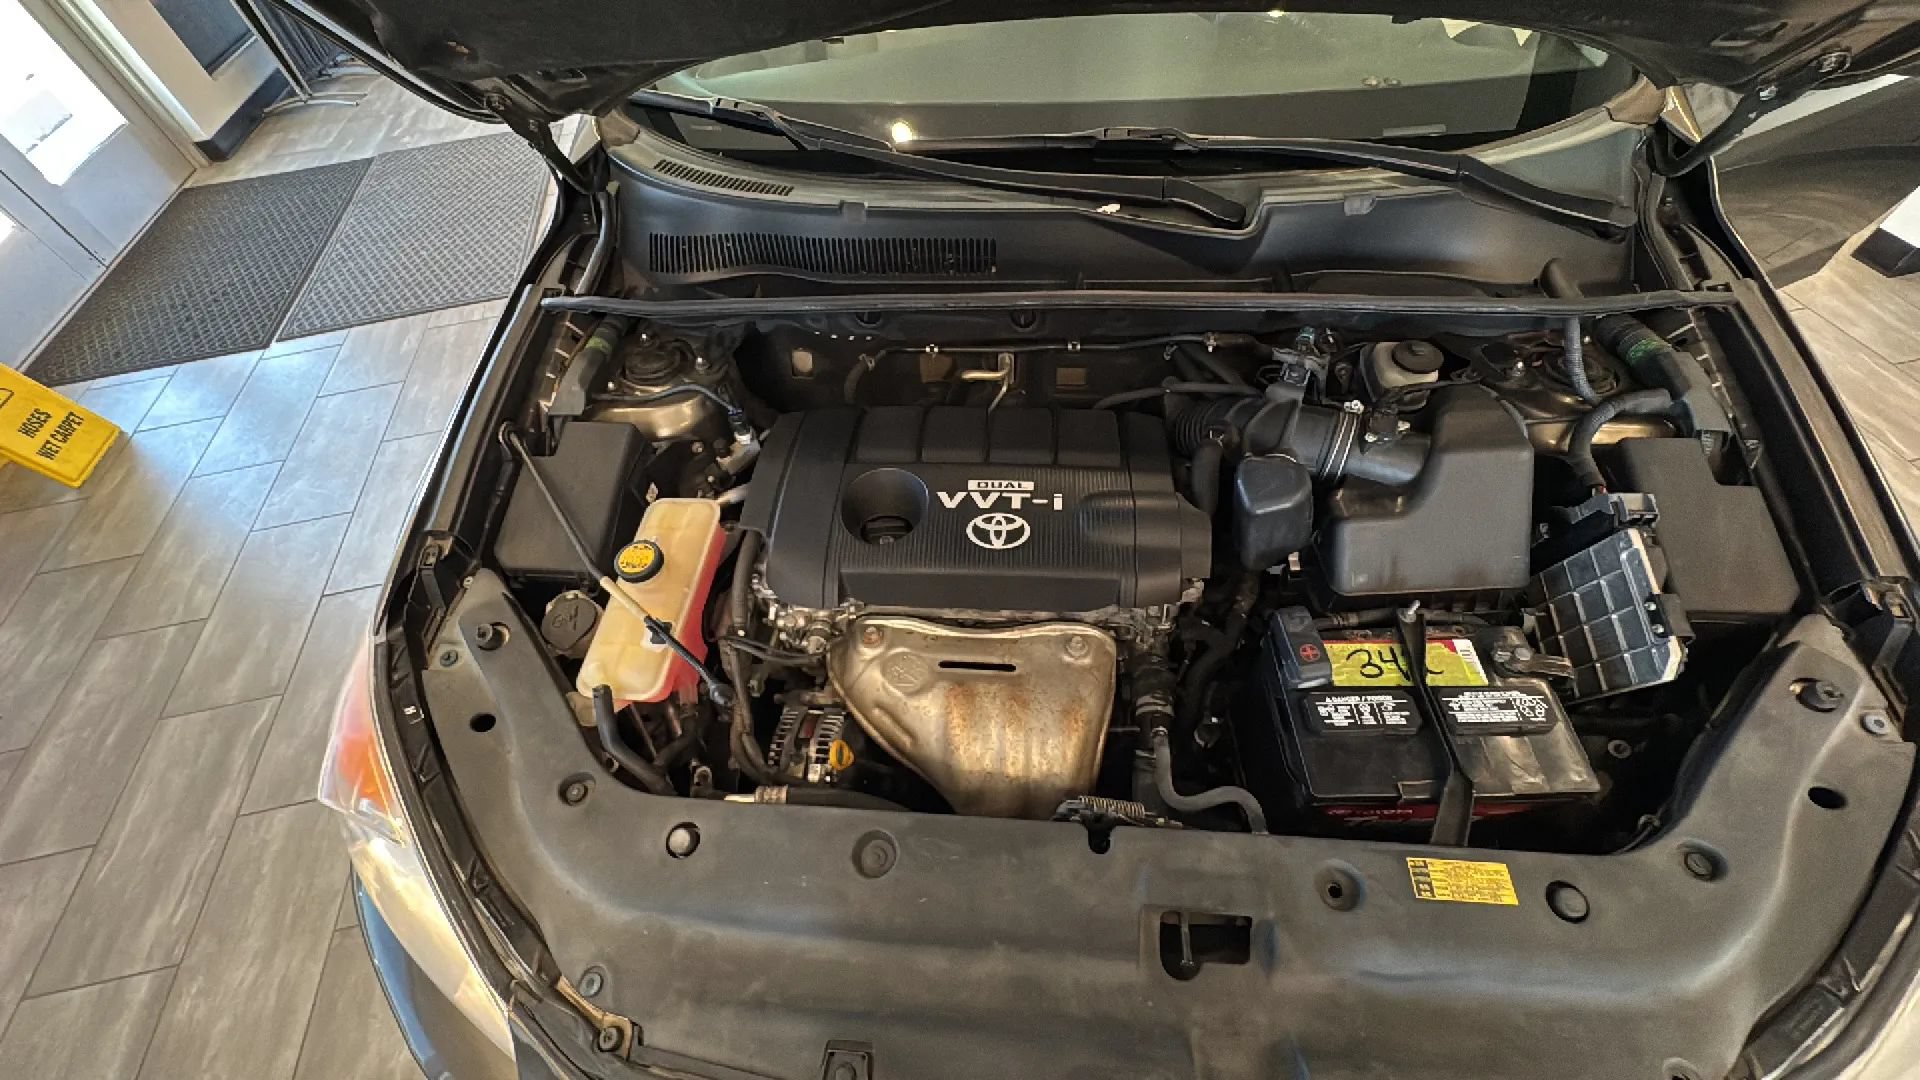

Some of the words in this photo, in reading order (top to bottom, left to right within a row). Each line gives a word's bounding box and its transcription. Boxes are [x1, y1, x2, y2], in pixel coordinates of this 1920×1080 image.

[36, 440, 62, 460] WET
[50, 411, 84, 443] CARPET
[973, 480, 1029, 489] DUAL
[936, 491, 1063, 511] VVT-i
